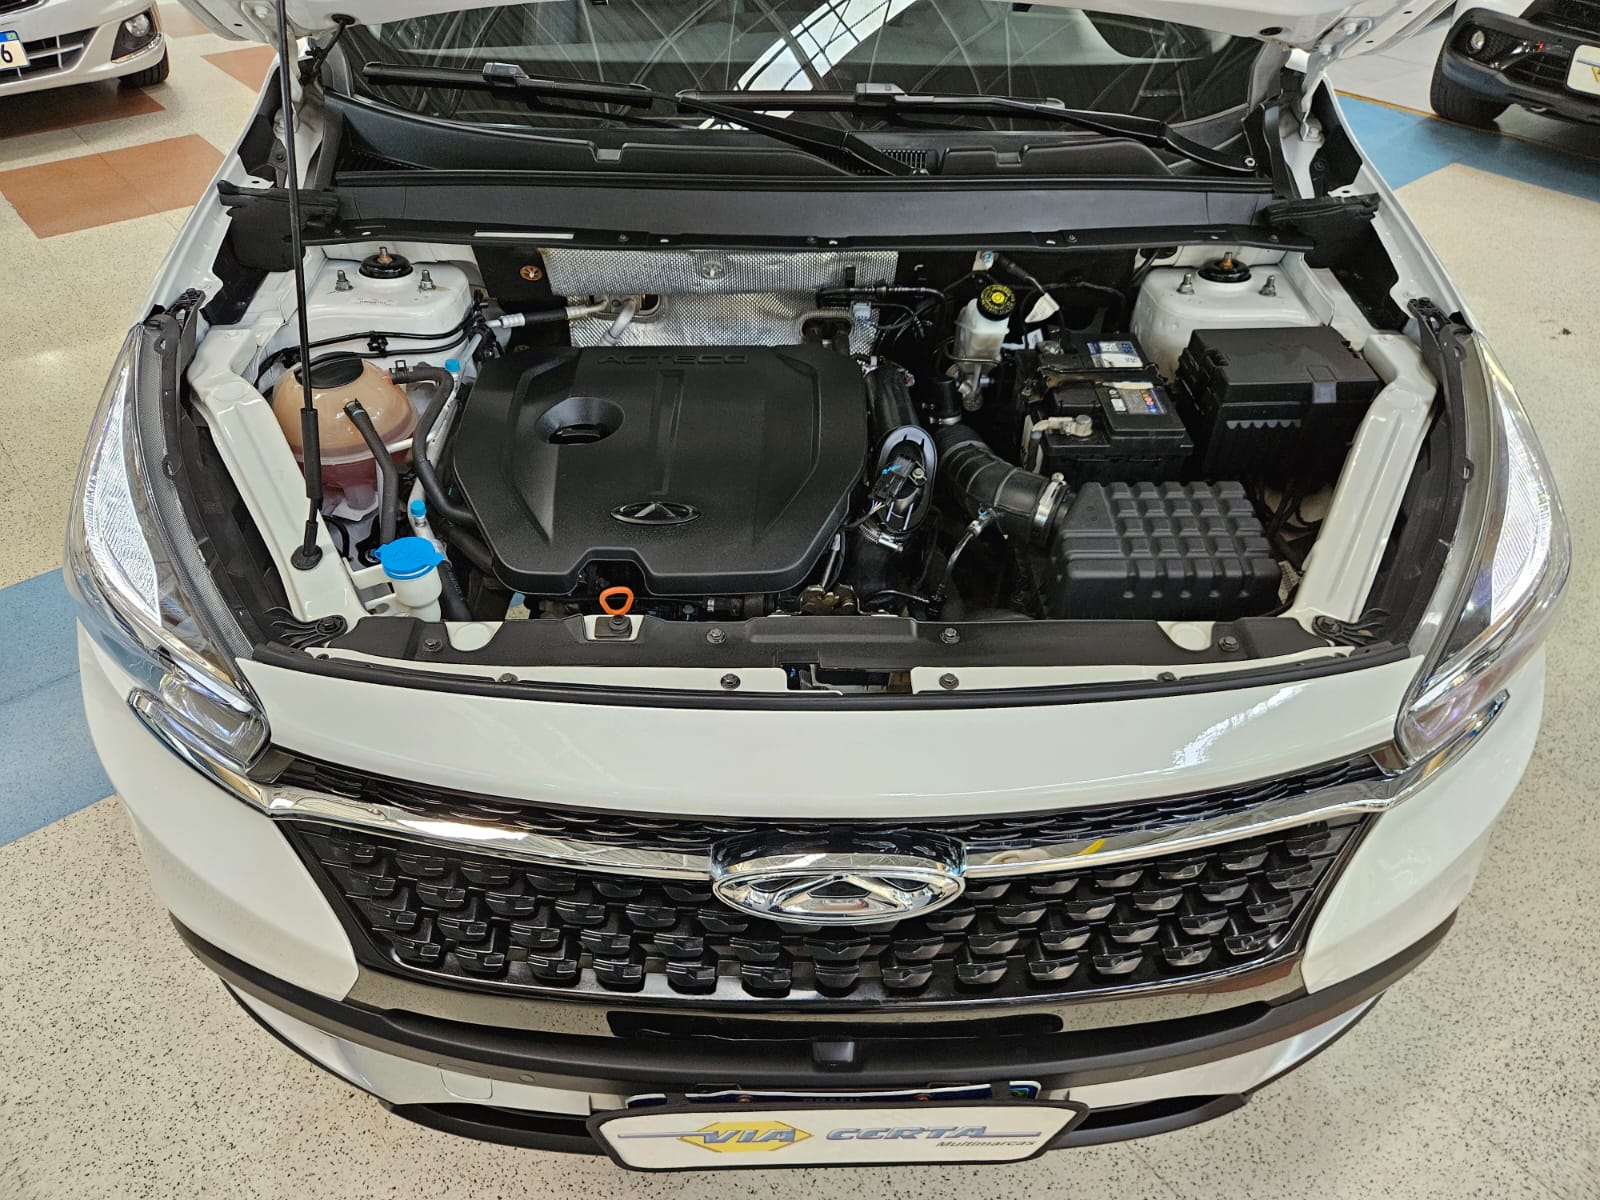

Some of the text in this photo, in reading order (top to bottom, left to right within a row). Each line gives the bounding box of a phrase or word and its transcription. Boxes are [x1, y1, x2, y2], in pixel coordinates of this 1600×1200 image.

[0, 44, 13, 63] 6
[597, 353, 748, 365] ACTECO
[703, 1125, 987, 1144] VIA CERTA
[935, 1140, 1036, 1148] Multimarcas
